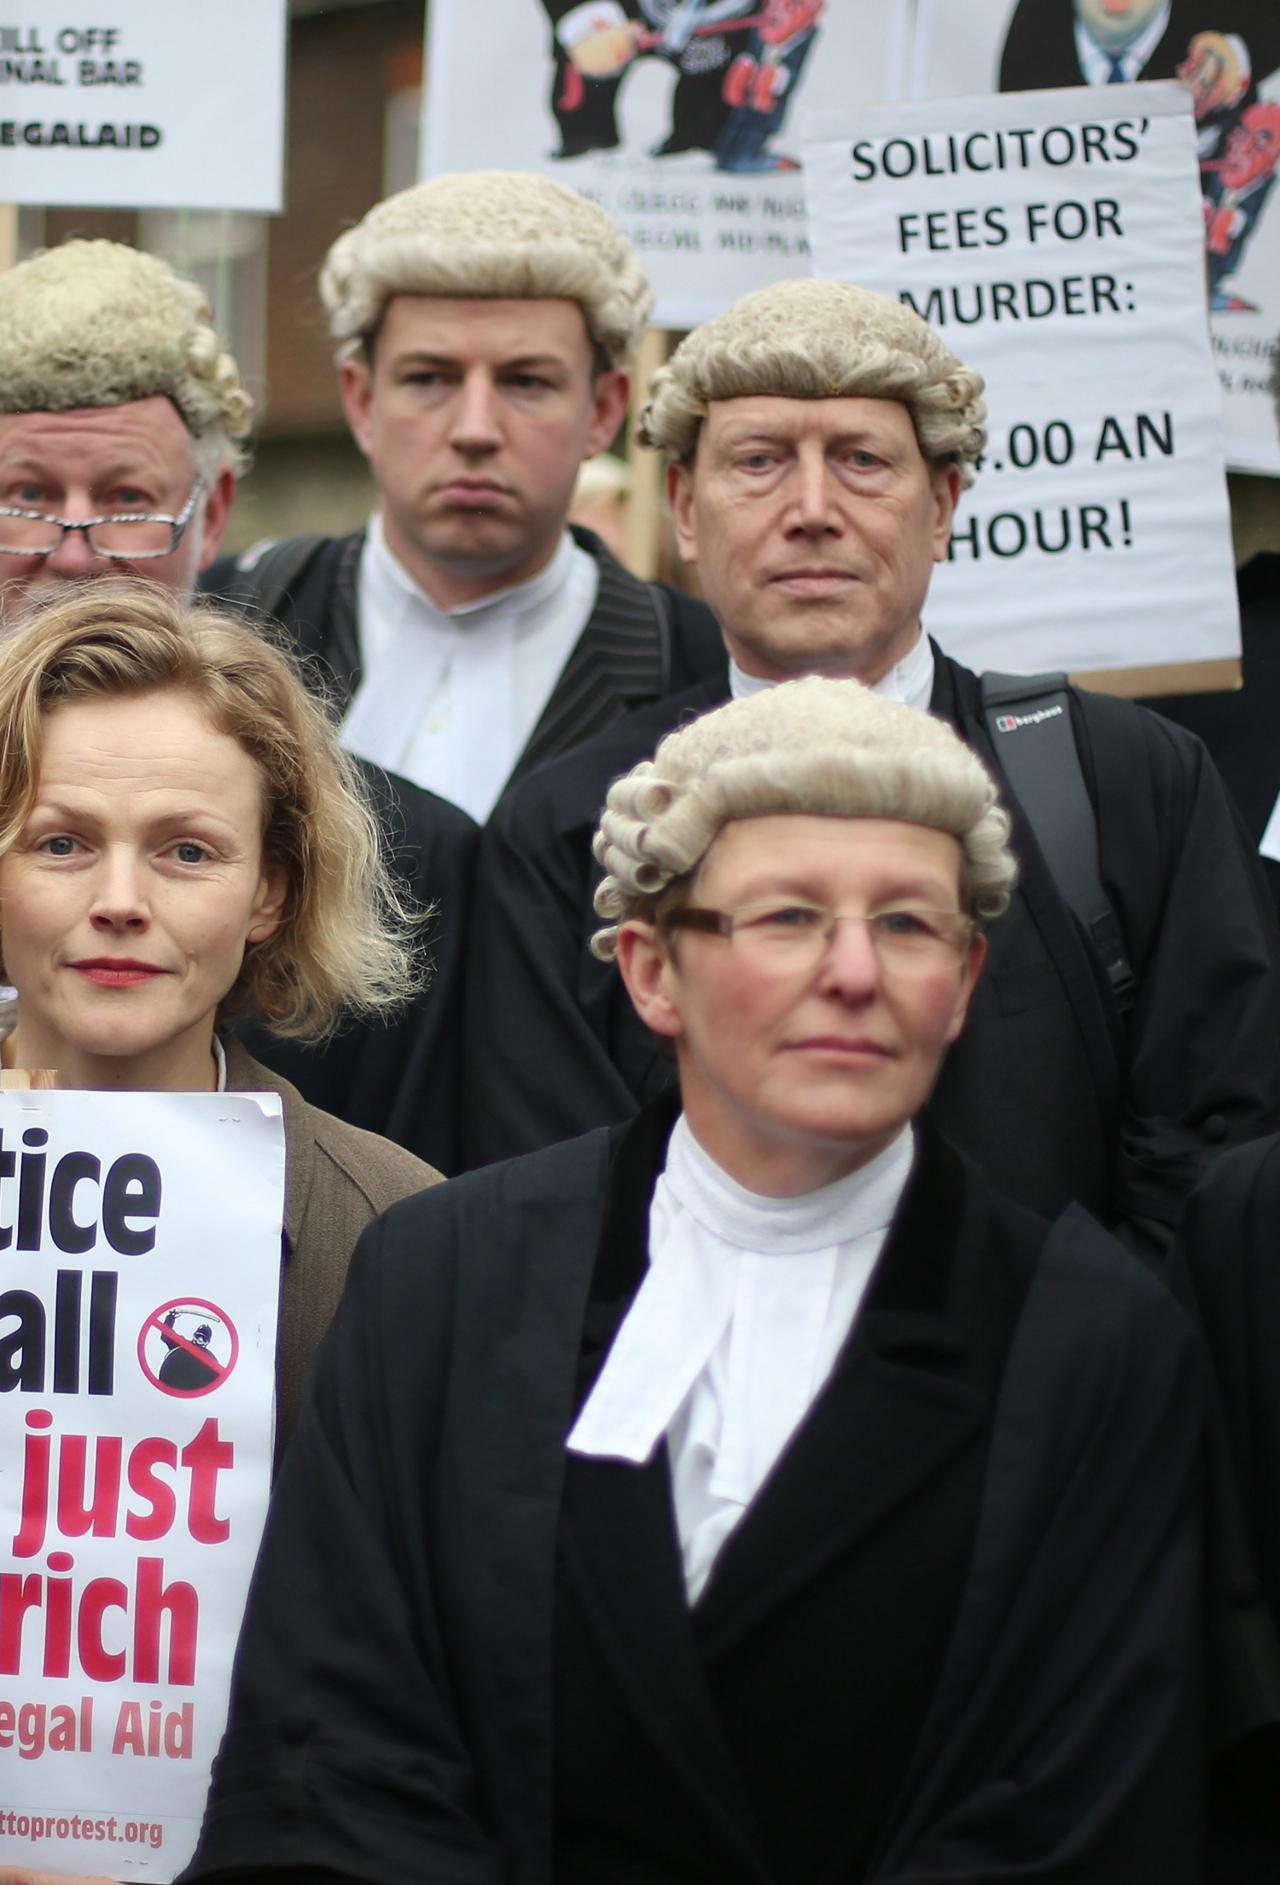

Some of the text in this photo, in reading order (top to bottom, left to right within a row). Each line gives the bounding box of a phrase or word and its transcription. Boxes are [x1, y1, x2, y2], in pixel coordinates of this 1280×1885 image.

[57, 28, 122, 54] OFF
[78, 59, 143, 87] BAR
[898, 199, 1124, 253] FEES FOR
[900, 273, 1136, 326] MURDER:
[1094, 411, 1175, 463] AN
[947, 498, 1133, 562] HOUR!
[12, 1408, 235, 1559] just
[111, 1699, 194, 1759] Aid
